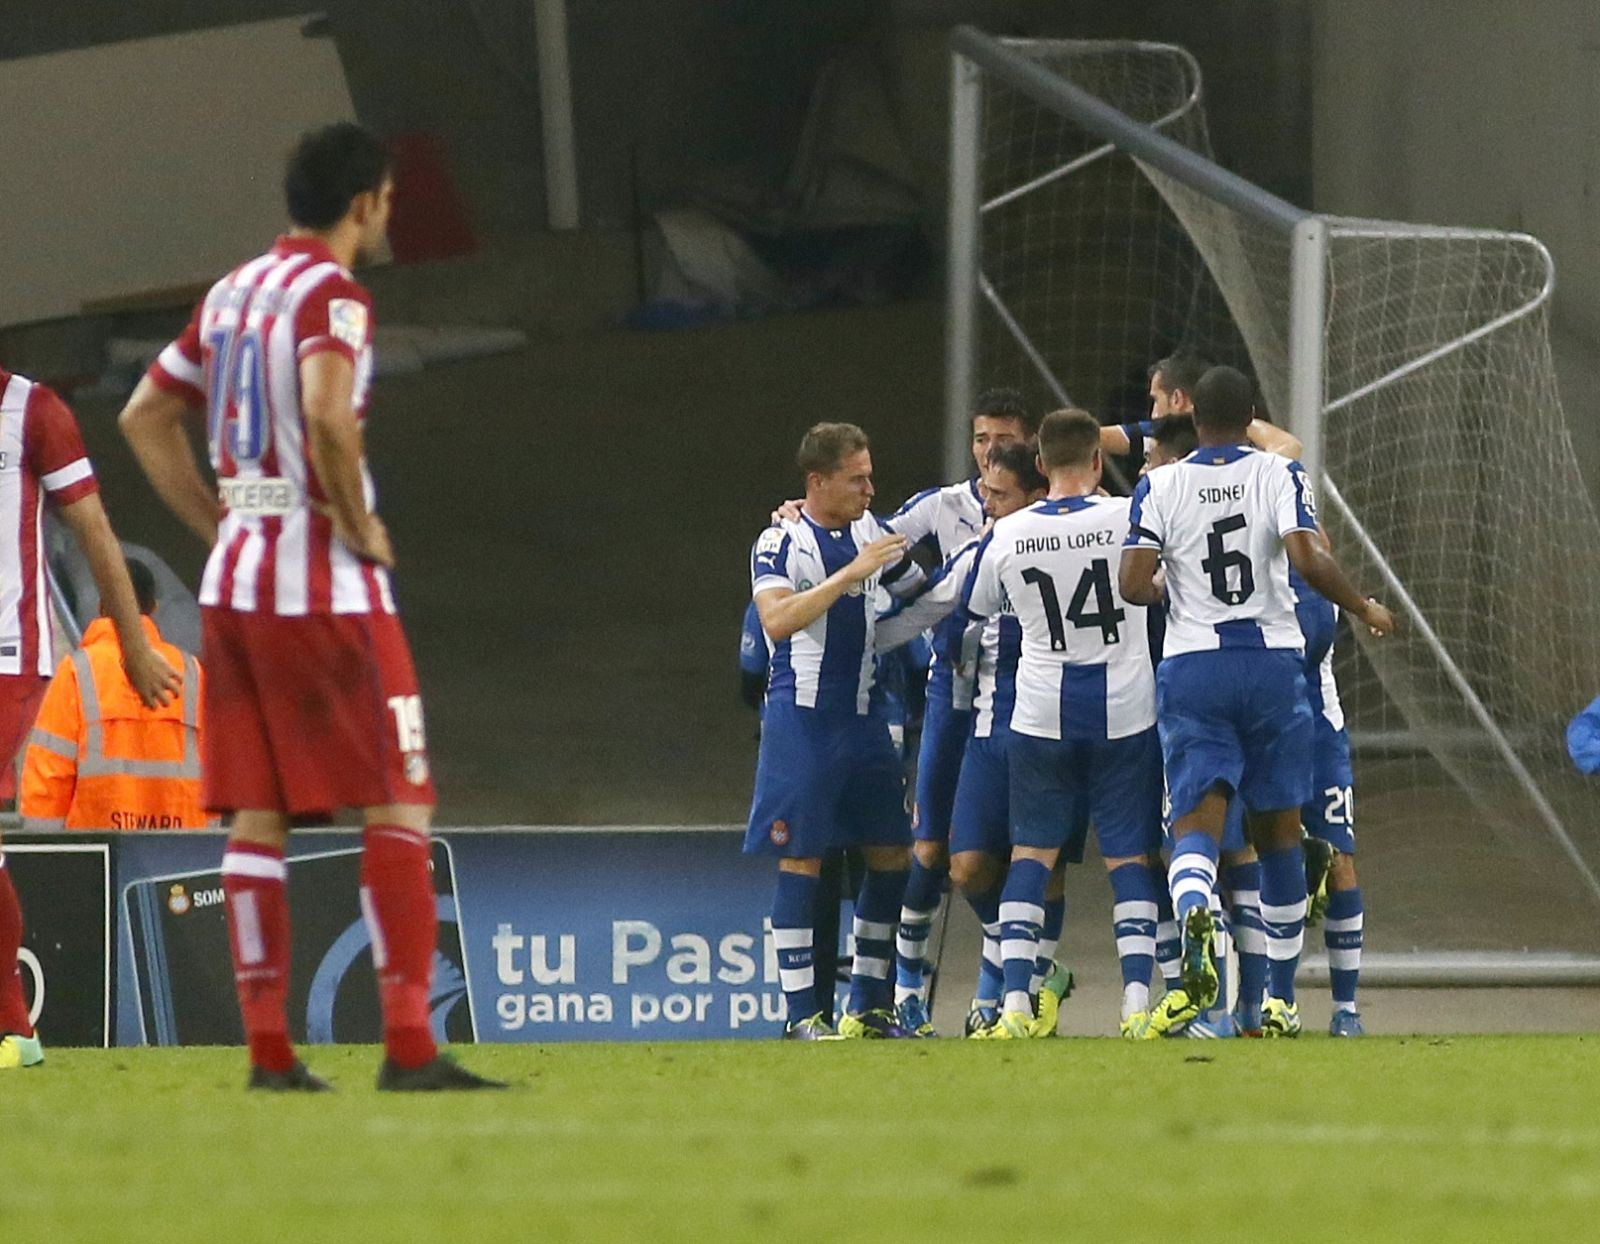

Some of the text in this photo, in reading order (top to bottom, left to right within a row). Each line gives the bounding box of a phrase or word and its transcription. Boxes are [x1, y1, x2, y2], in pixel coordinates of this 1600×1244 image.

[208, 327, 268, 461] 19
[1198, 485, 1246, 504] SIDNEI
[1015, 530, 1115, 555] DAVID LOPEZ
[1201, 513, 1255, 606] 6
[1021, 558, 1125, 651] 14
[111, 811, 183, 830] STEWARD
[193, 888, 226, 908] SOM
[492, 922, 576, 985] tu
[496, 992, 613, 1030] gana
[631, 992, 713, 1029] por
